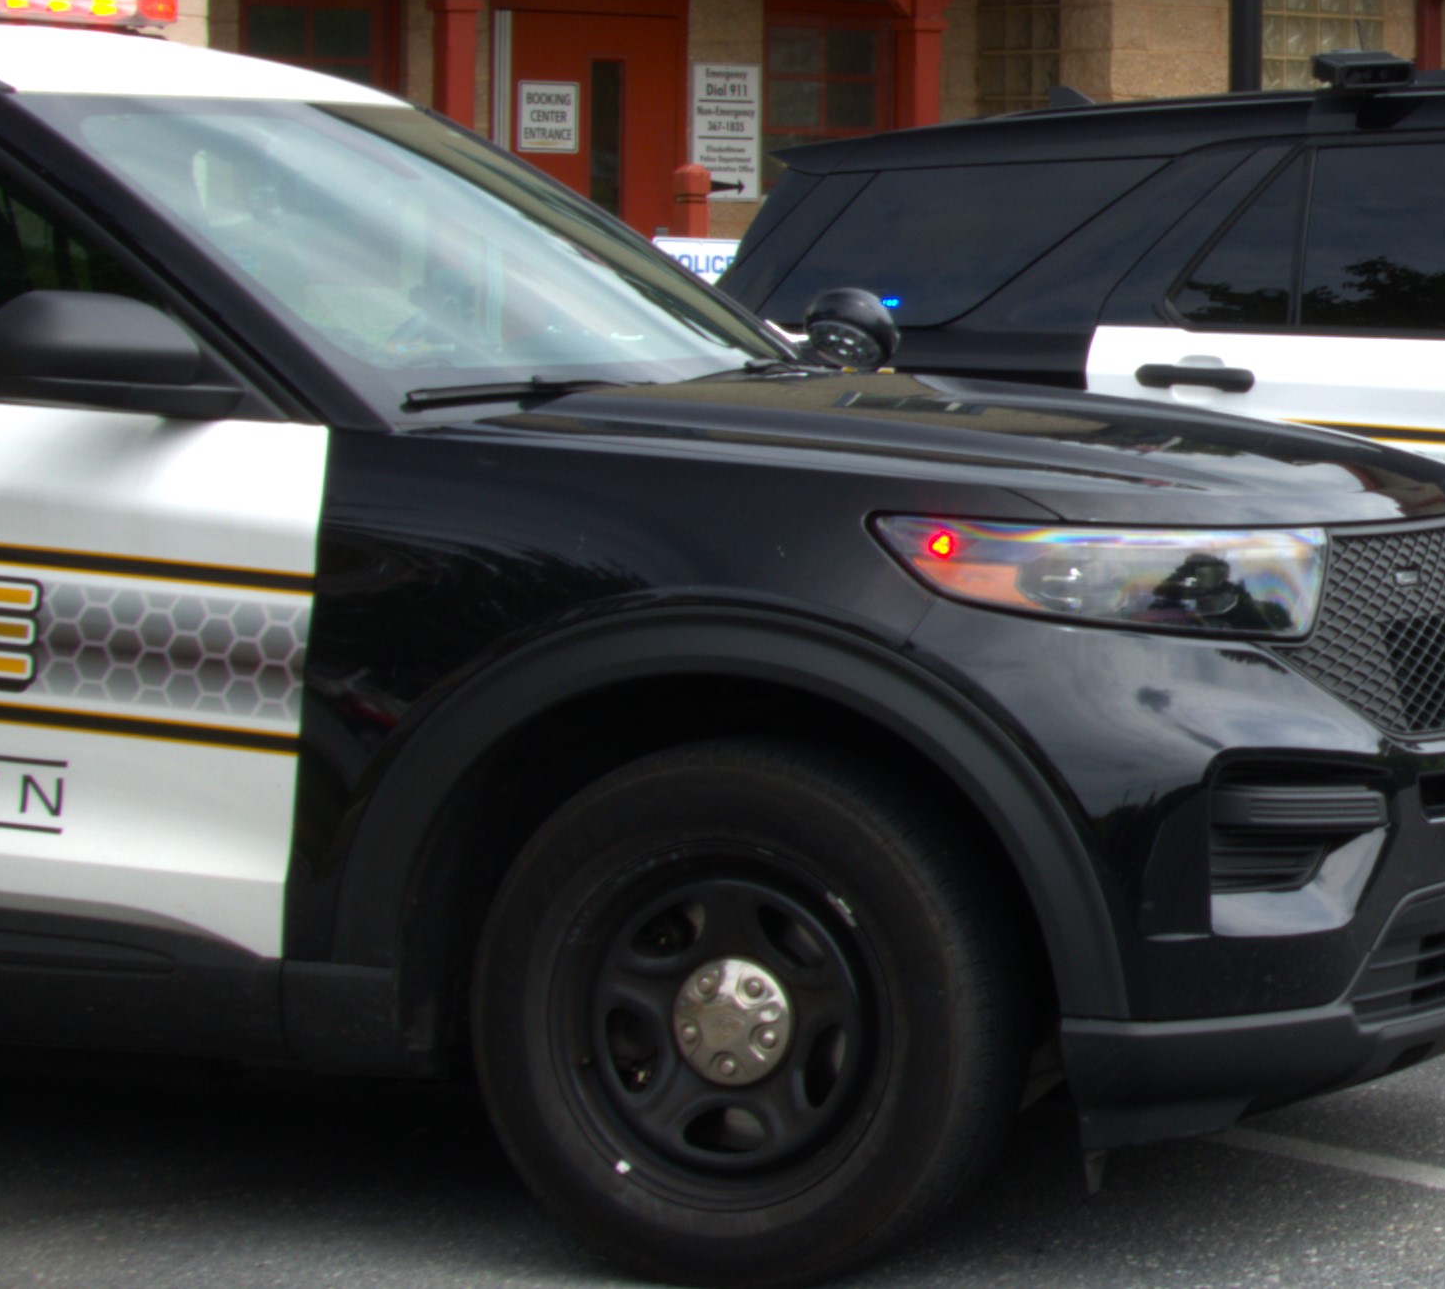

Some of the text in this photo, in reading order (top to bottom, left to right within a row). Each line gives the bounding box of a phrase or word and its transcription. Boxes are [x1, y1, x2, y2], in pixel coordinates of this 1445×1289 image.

[705, 67, 747, 81] Emergency
[707, 84, 748, 97] Dial 911
[526, 92, 572, 106] BOOKING
[530, 110, 567, 123] CENTER
[697, 106, 755, 119] Non-Emergency
[524, 127, 572, 141] ENTRANCE
